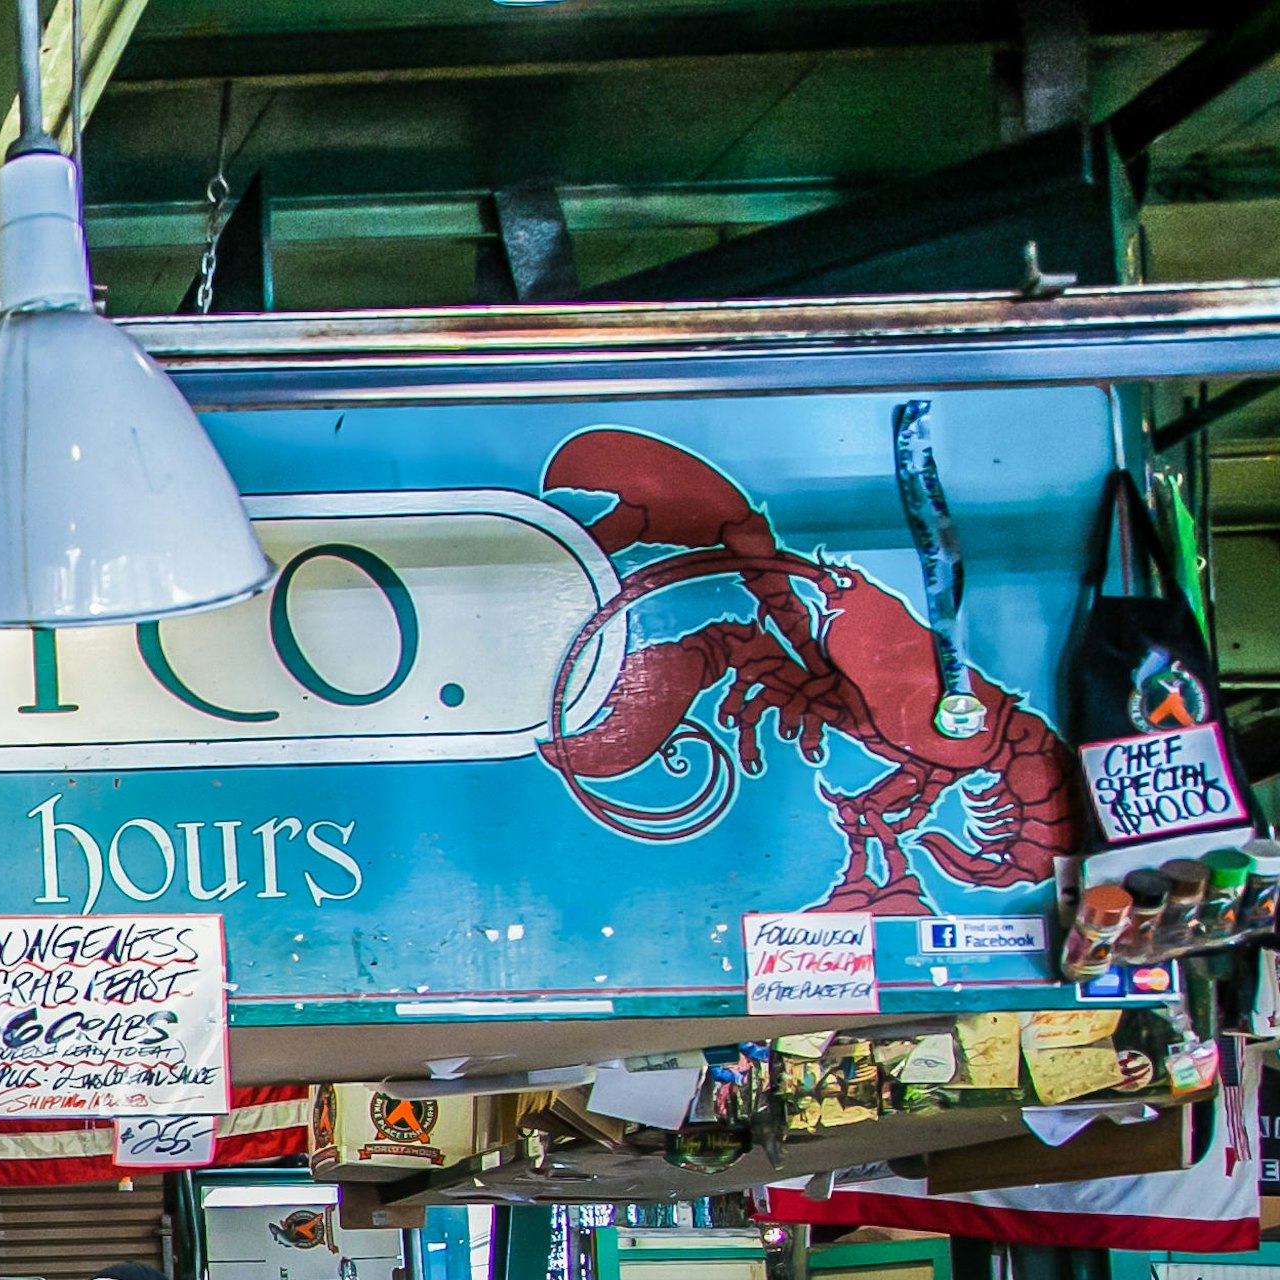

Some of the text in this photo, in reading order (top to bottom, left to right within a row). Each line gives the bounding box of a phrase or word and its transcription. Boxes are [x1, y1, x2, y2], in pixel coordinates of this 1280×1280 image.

[136, 543, 465, 723] CO.
[1104, 735, 1183, 777] CHEF
[1096, 763, 1219, 805] SPECIAL
[27, 793, 364, 917] hours
[965, 933, 1035, 948] Facebook
[754, 950, 873, 976] INSTAGRAM
[83, 966, 199, 1005] FEAST
[2, 1007, 178, 1048] 6 CRABS
